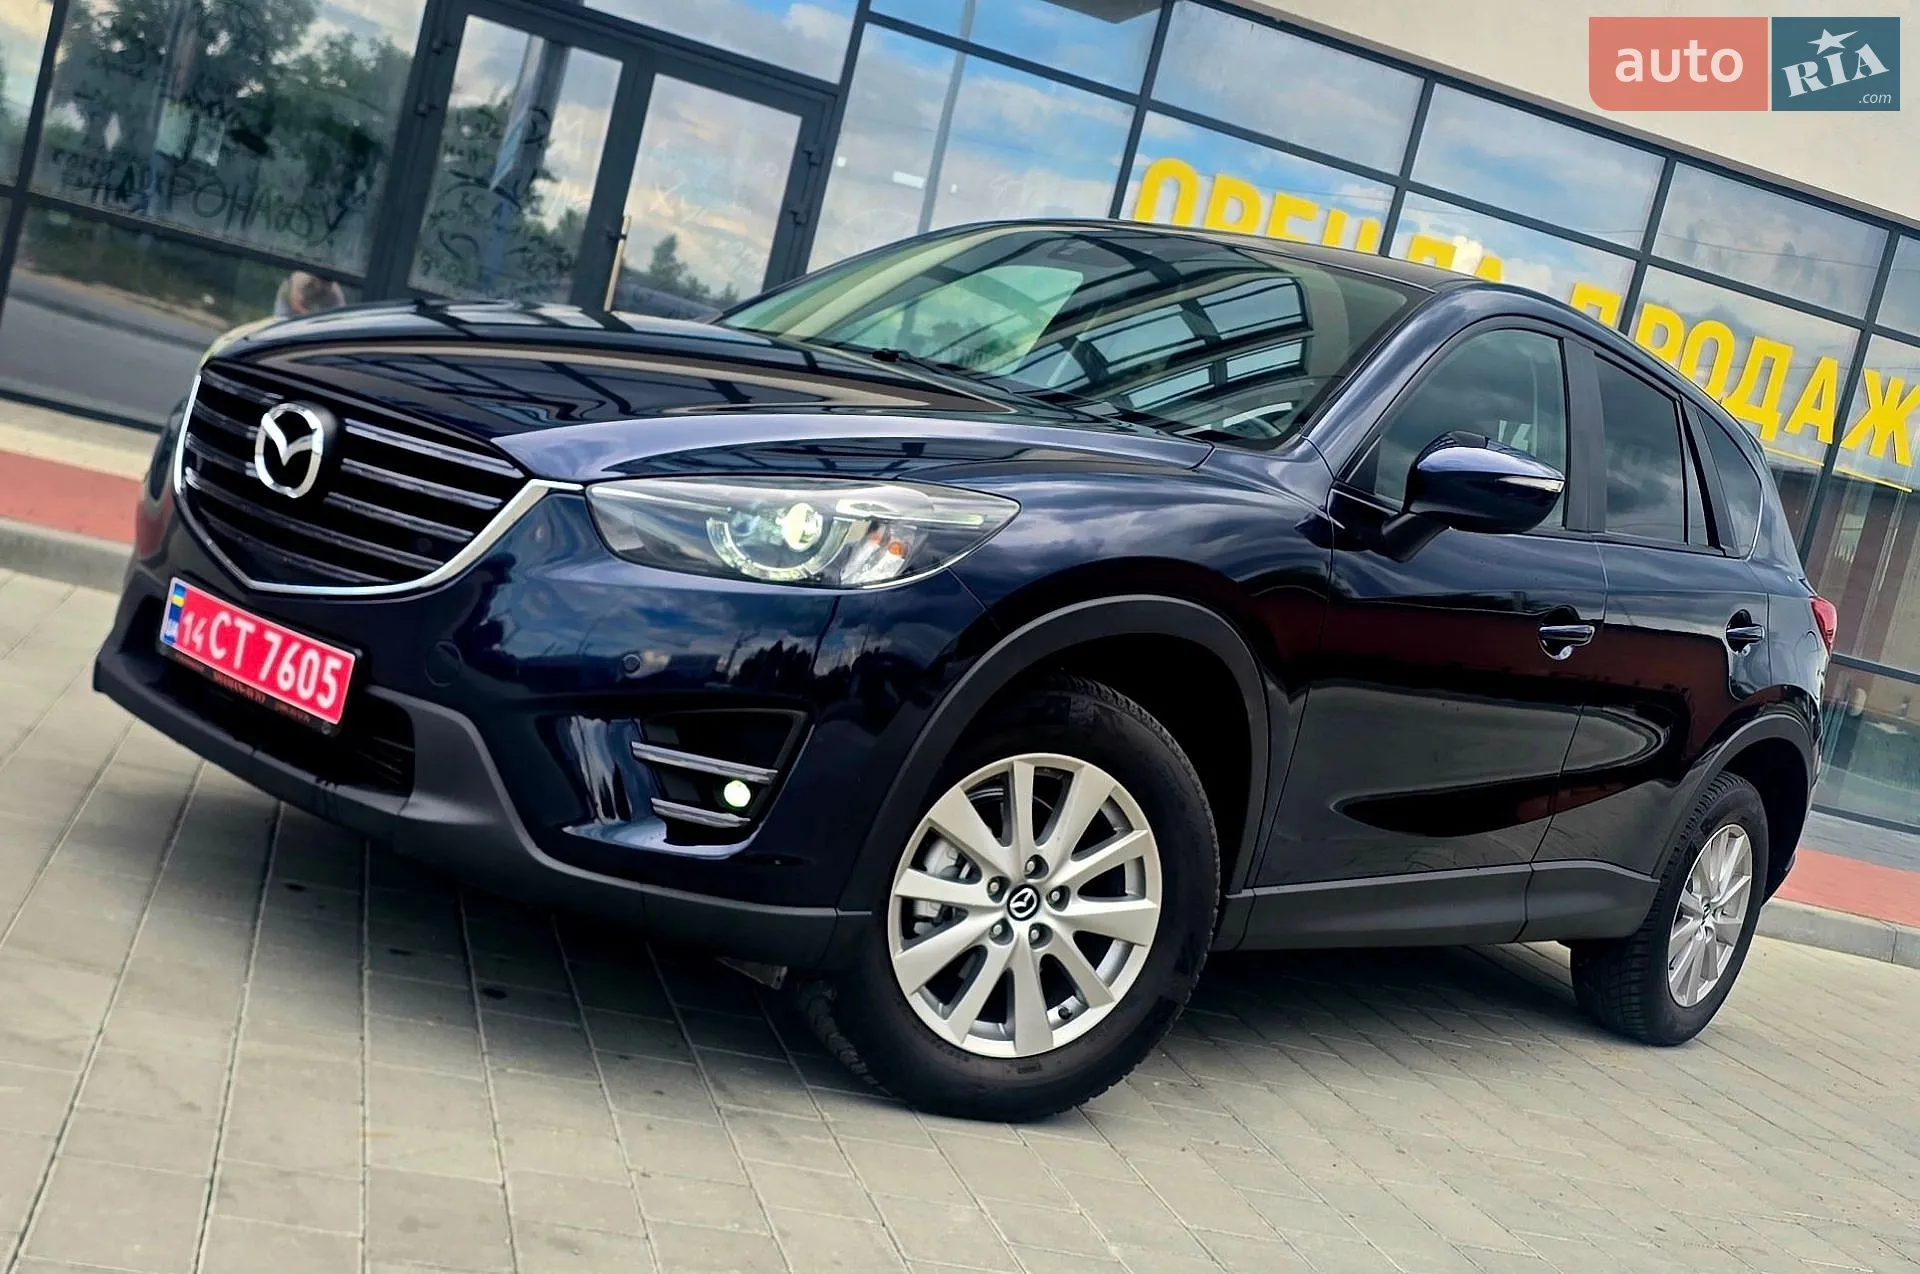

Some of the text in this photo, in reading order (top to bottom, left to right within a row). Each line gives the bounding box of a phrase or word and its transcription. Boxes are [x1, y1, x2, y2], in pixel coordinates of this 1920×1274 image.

[182, 611, 208, 652] 14
[208, 610, 257, 670] CT
[258, 631, 343, 710] 7605
